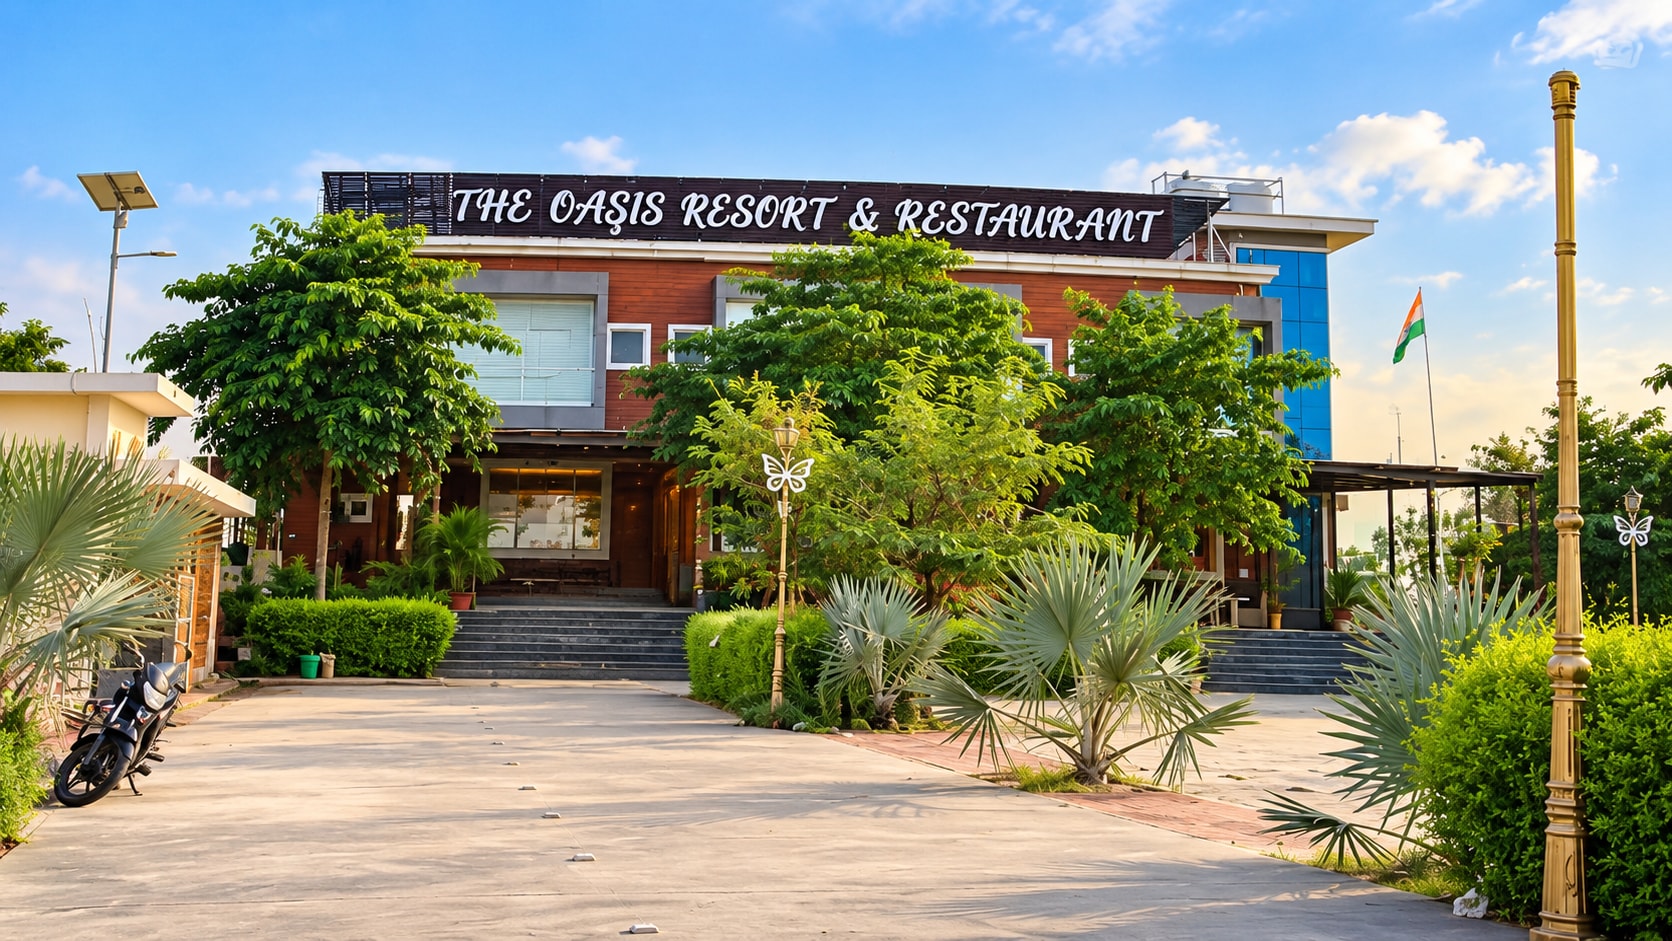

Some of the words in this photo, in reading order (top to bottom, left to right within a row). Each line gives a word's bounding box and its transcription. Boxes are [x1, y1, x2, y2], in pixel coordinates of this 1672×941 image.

[452, 187, 532, 224] THE
[680, 192, 839, 232] RESORT
[848, 197, 880, 232] &
[894, 198, 1165, 243] RESTAURANT
